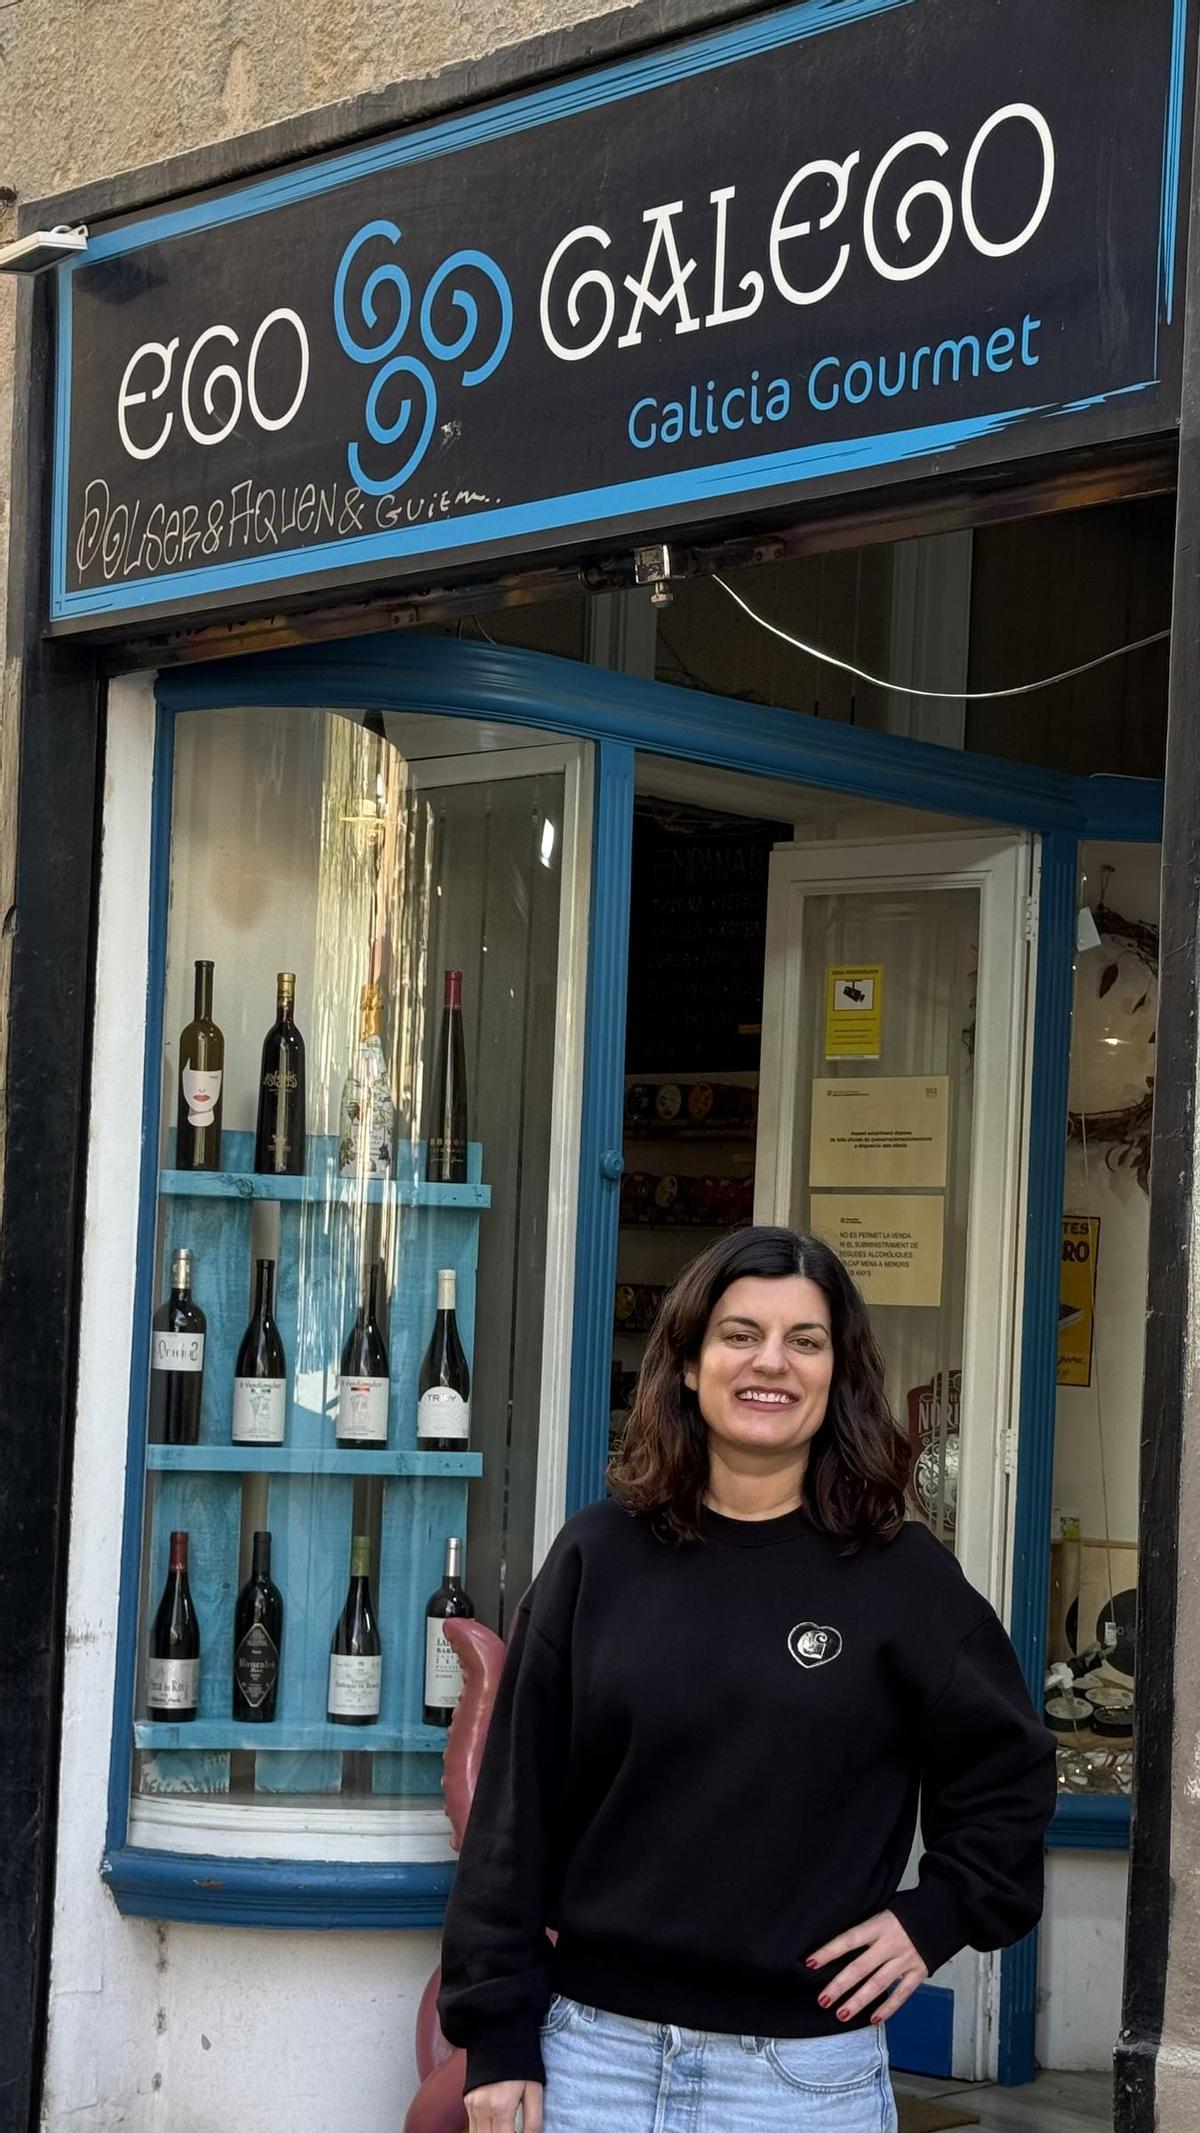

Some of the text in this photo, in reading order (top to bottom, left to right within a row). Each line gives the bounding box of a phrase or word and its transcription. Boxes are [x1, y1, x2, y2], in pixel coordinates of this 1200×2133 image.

[539, 102, 1055, 361] GALEGO
[627, 314, 1042, 449] Galicia Gourmet
